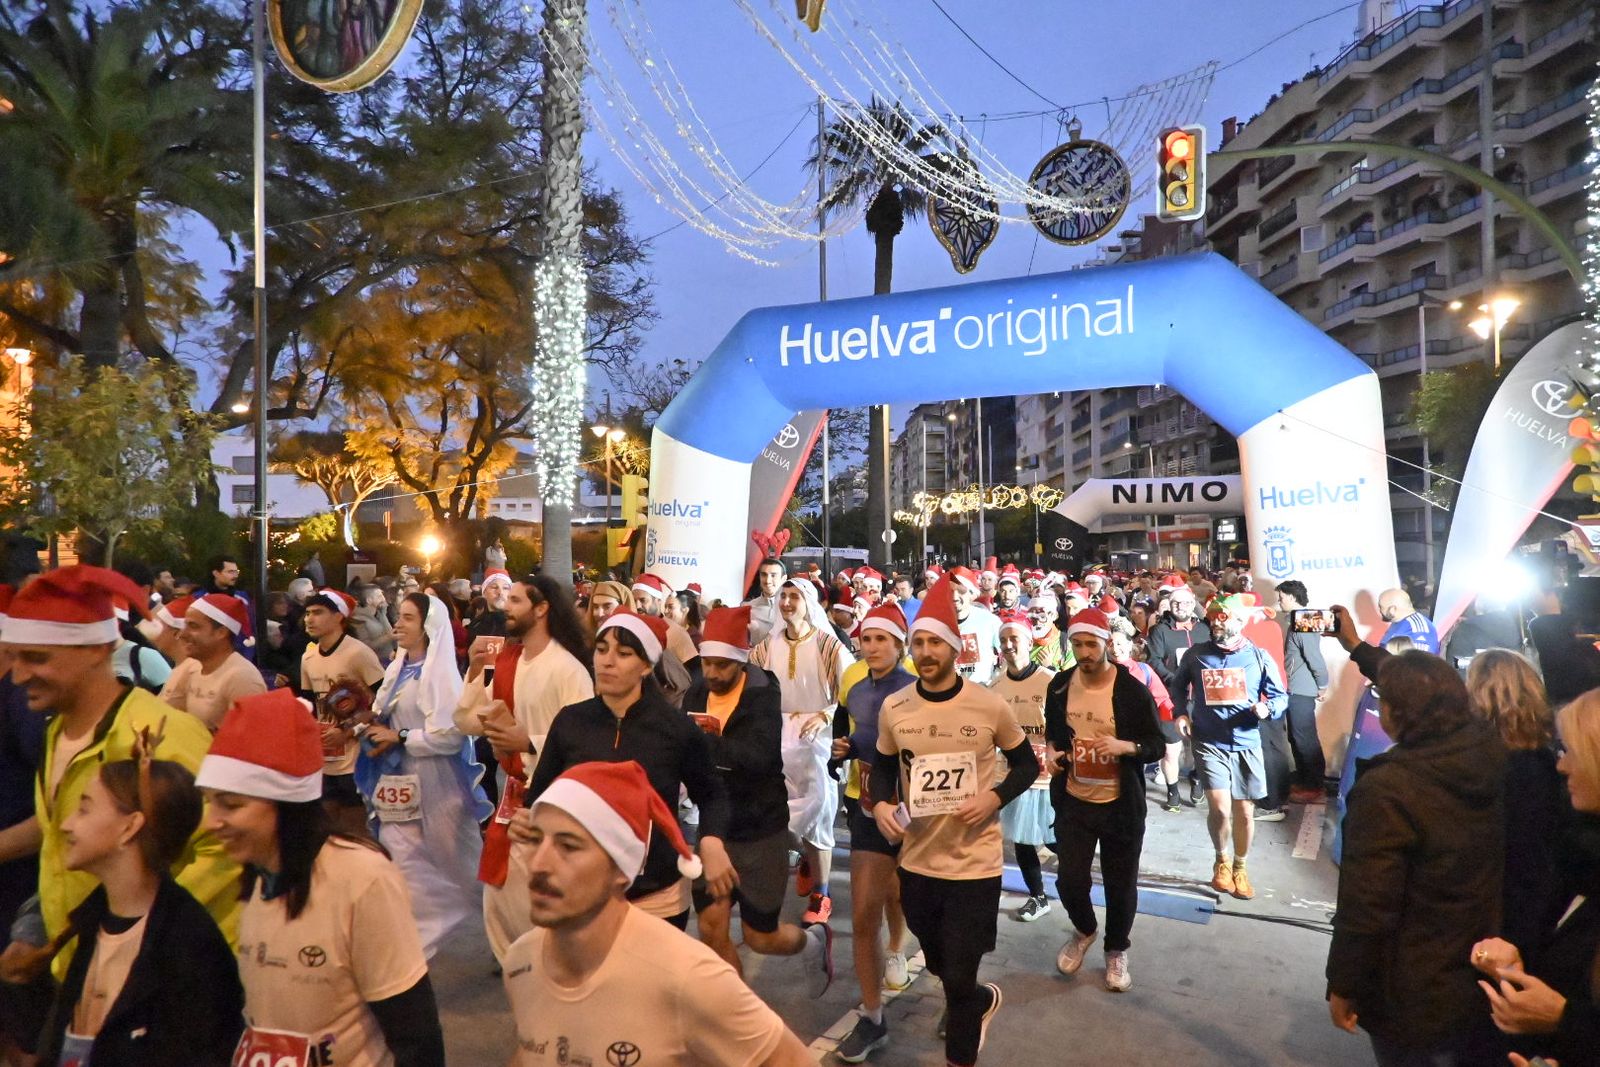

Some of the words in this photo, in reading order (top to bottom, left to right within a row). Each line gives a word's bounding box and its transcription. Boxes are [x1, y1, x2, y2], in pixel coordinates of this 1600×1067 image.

[780, 314, 936, 366] Huelva
[954, 283, 1134, 357] original
[1503, 407, 1567, 448] HUELVA
[1112, 481, 1228, 504] NIMO
[1259, 480, 1360, 510] Huelva
[658, 555, 698, 567] HUELVA
[1301, 556, 1365, 571] HUELVA
[921, 768, 965, 793] 227
[376, 786, 411, 804] 435
